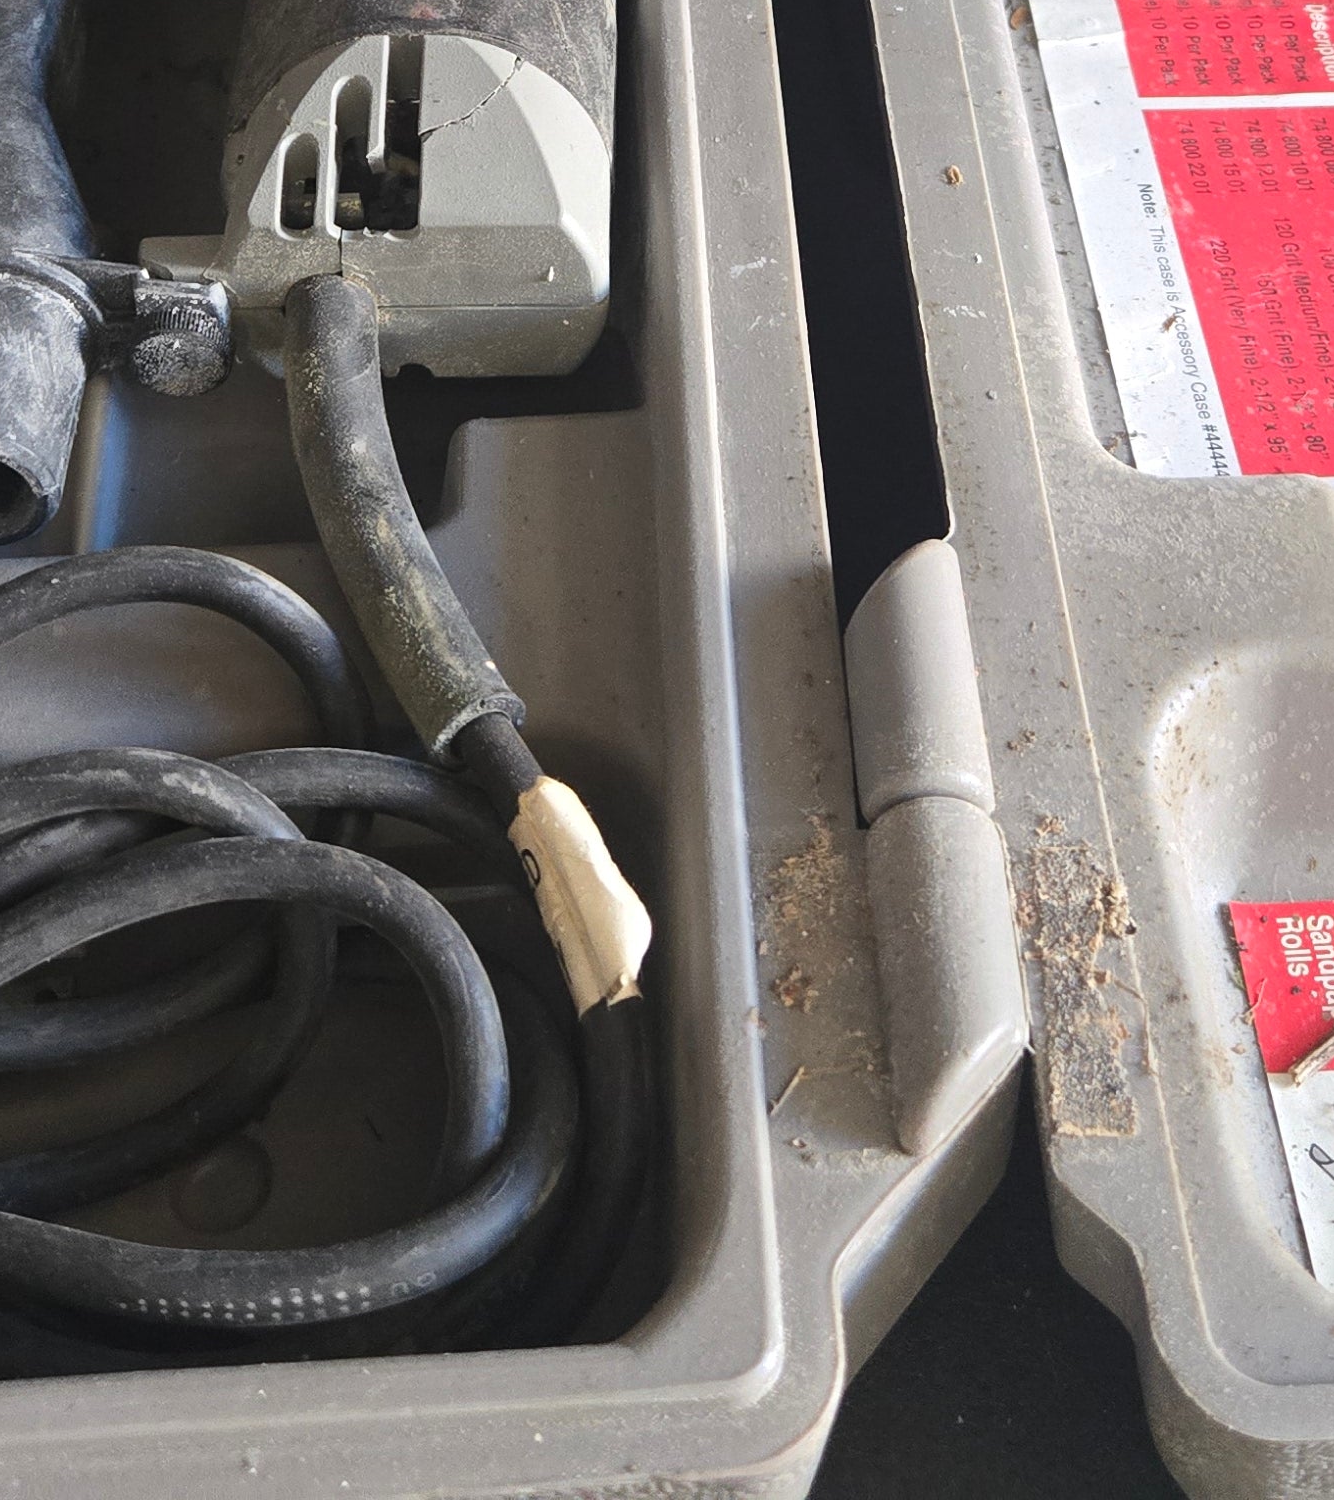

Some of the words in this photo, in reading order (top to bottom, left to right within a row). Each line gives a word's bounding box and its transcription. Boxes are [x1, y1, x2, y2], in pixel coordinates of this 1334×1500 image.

[1180, 137, 1202, 159] 800
[1187, 162, 1206, 176] 22
[1137, 183, 1158, 218] Note:
[1148, 226, 1169, 253] This
[1272, 217, 1295, 237] 120
[1209, 240, 1232, 263] 220
[1156, 256, 1176, 287] case
[1217, 266, 1240, 291] Grit
[1165, 291, 1182, 301] is
[1170, 304, 1199, 377] Accessory
[1189, 382, 1214, 419] Case
[1262, 423, 1278, 431] x
[1276, 916, 1313, 977] Rolls
